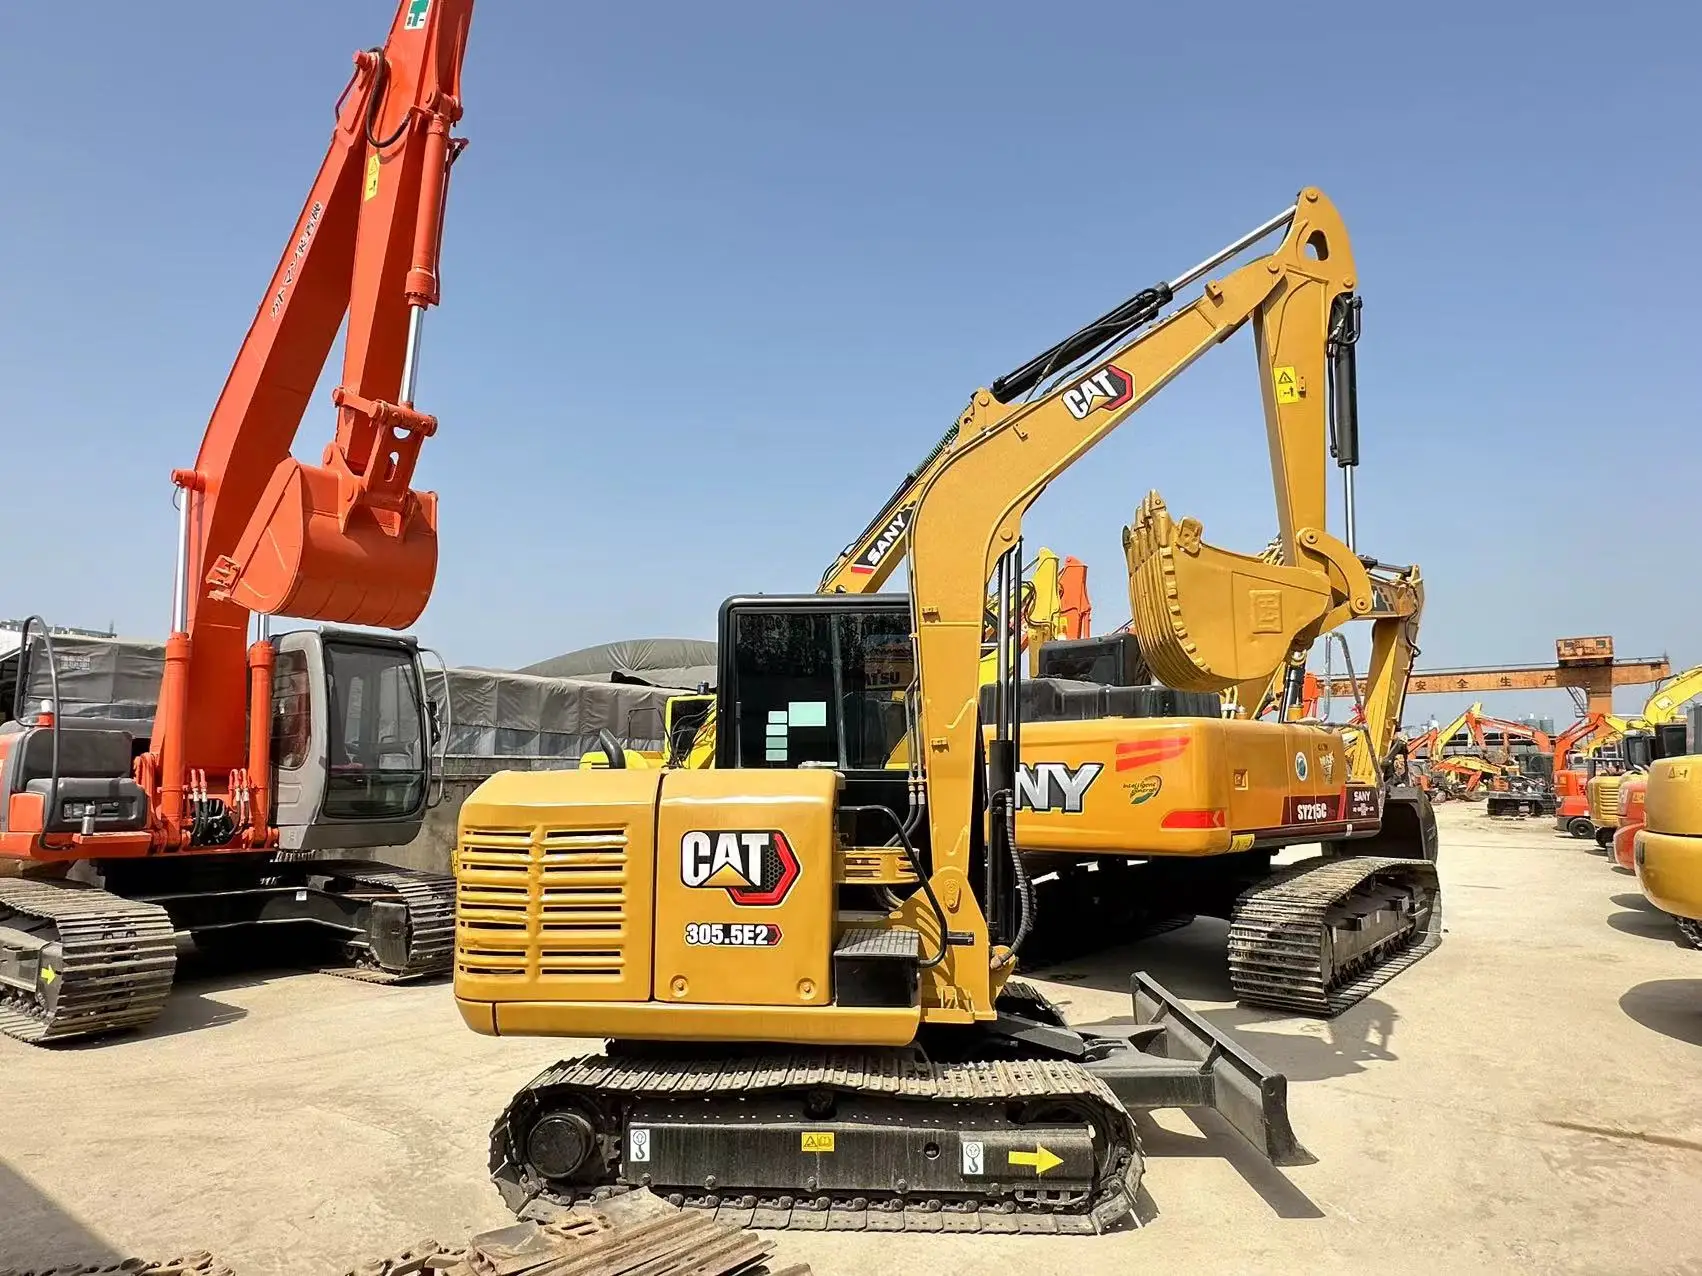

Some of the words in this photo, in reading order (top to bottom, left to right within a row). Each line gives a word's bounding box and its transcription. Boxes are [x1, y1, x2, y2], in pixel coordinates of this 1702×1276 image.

[1062, 368, 1119, 419] CAT
[867, 512, 906, 566] SANY
[1014, 762, 1104, 812] NY
[1297, 803, 1327, 820] SY215C
[1353, 791, 1371, 802] SANY
[681, 830, 770, 887] CAT
[686, 923, 769, 945] 305.5E2
